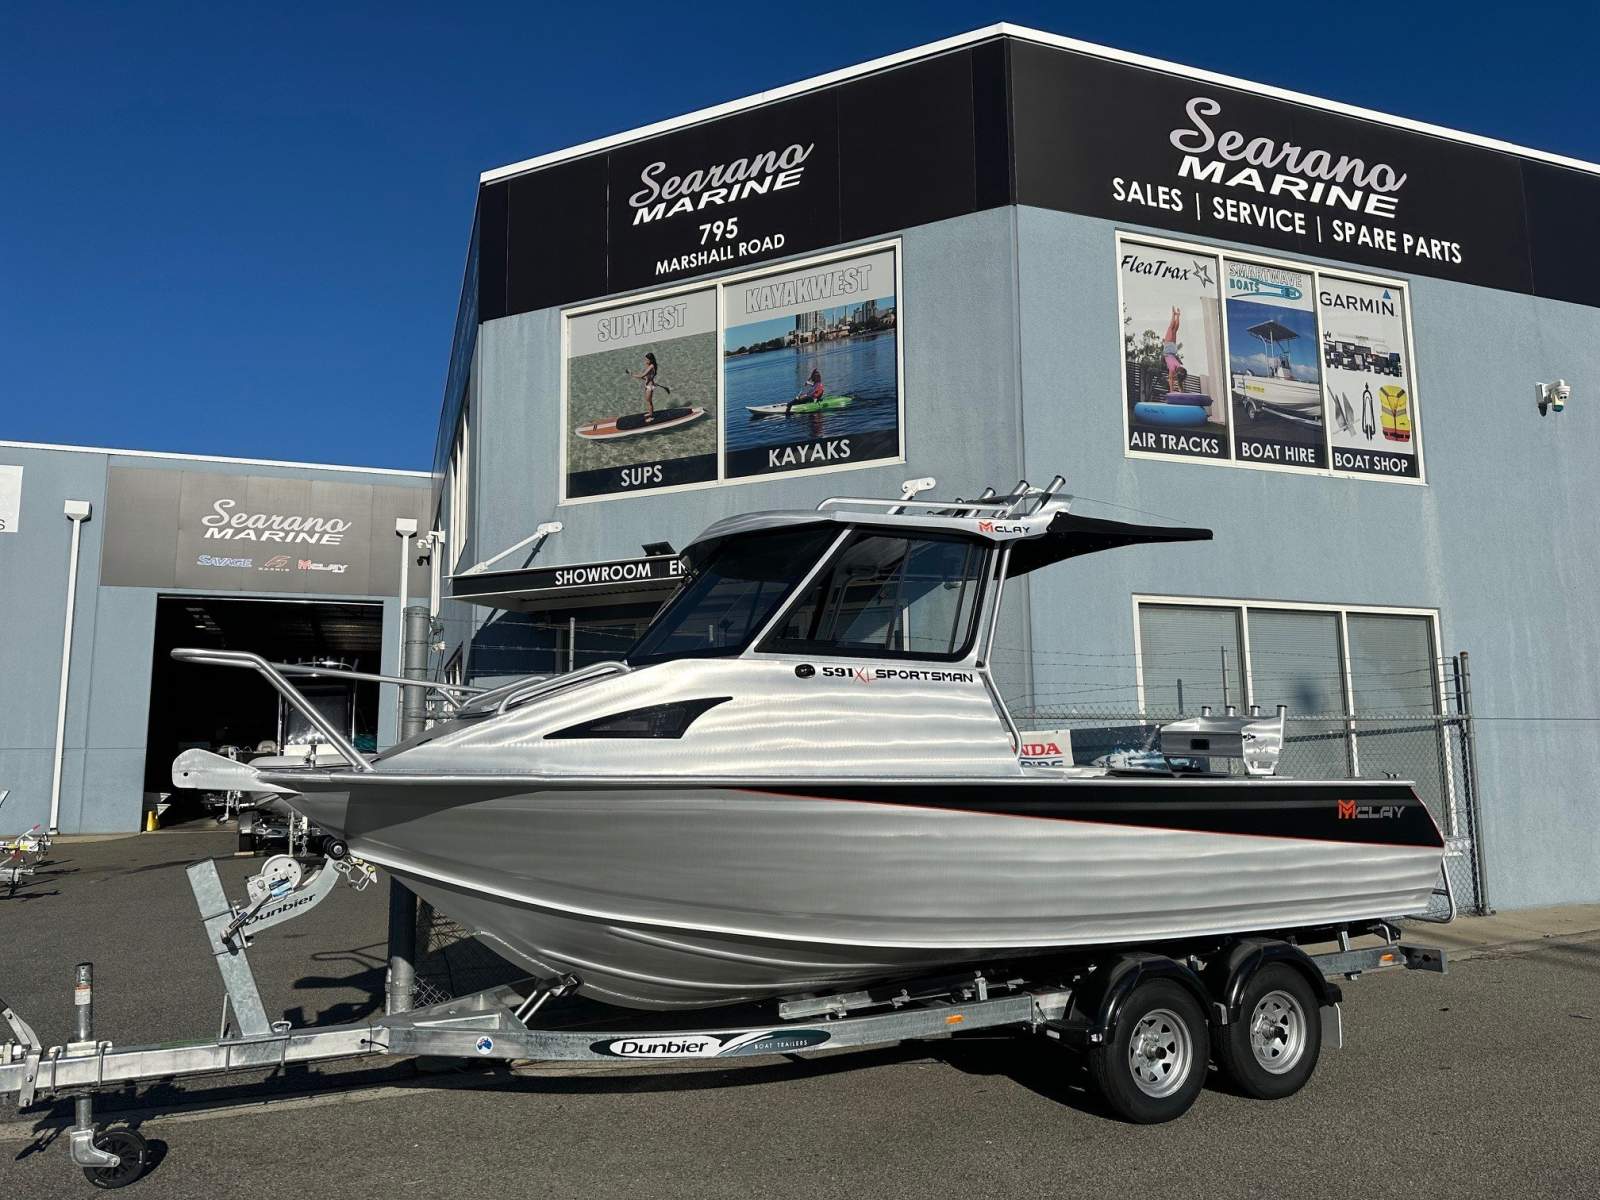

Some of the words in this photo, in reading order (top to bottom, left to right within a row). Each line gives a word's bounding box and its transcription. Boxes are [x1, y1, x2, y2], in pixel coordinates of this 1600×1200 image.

[1169, 97, 1408, 193] Searano
[628, 143, 815, 208] Searano
[1177, 155, 1400, 219] MARINE
[632, 167, 805, 226] MARINE
[699, 217, 739, 245] 795
[1112, 177, 1184, 212] SALES
[1213, 197, 1306, 235] SERVICE
[1333, 219, 1397, 253] SPARE
[1403, 233, 1462, 264] PARTS
[655, 246, 734, 276] MARSHALL
[739, 234, 785, 258] ROAD
[1121, 255, 1191, 280] FleaTrax
[1229, 263, 1303, 288] SMARTWAVE
[1230, 278, 1260, 293] BOATS
[745, 264, 872, 314] KAYAKWEST
[1320, 291, 1395, 317] GARMIN
[598, 303, 687, 342] SUPWEST
[768, 439, 851, 468] KAYAKS
[1131, 431, 1156, 449] AIR
[1160, 434, 1219, 454] TRACKS
[1242, 442, 1282, 460] BOAT
[1285, 446, 1315, 464] HIRE
[1335, 452, 1371, 469] BOAT
[1374, 456, 1408, 473] SHOP
[620, 465, 663, 487] SUPS
[201, 499, 352, 533] Searano
[203, 527, 345, 545] MARINE
[555, 562, 651, 585] SHOWROOM
[876, 669, 973, 684] SPORTSMAN
[620, 1040, 709, 1054] Dunbier
[777, 1039, 808, 1049] TRAILERS
